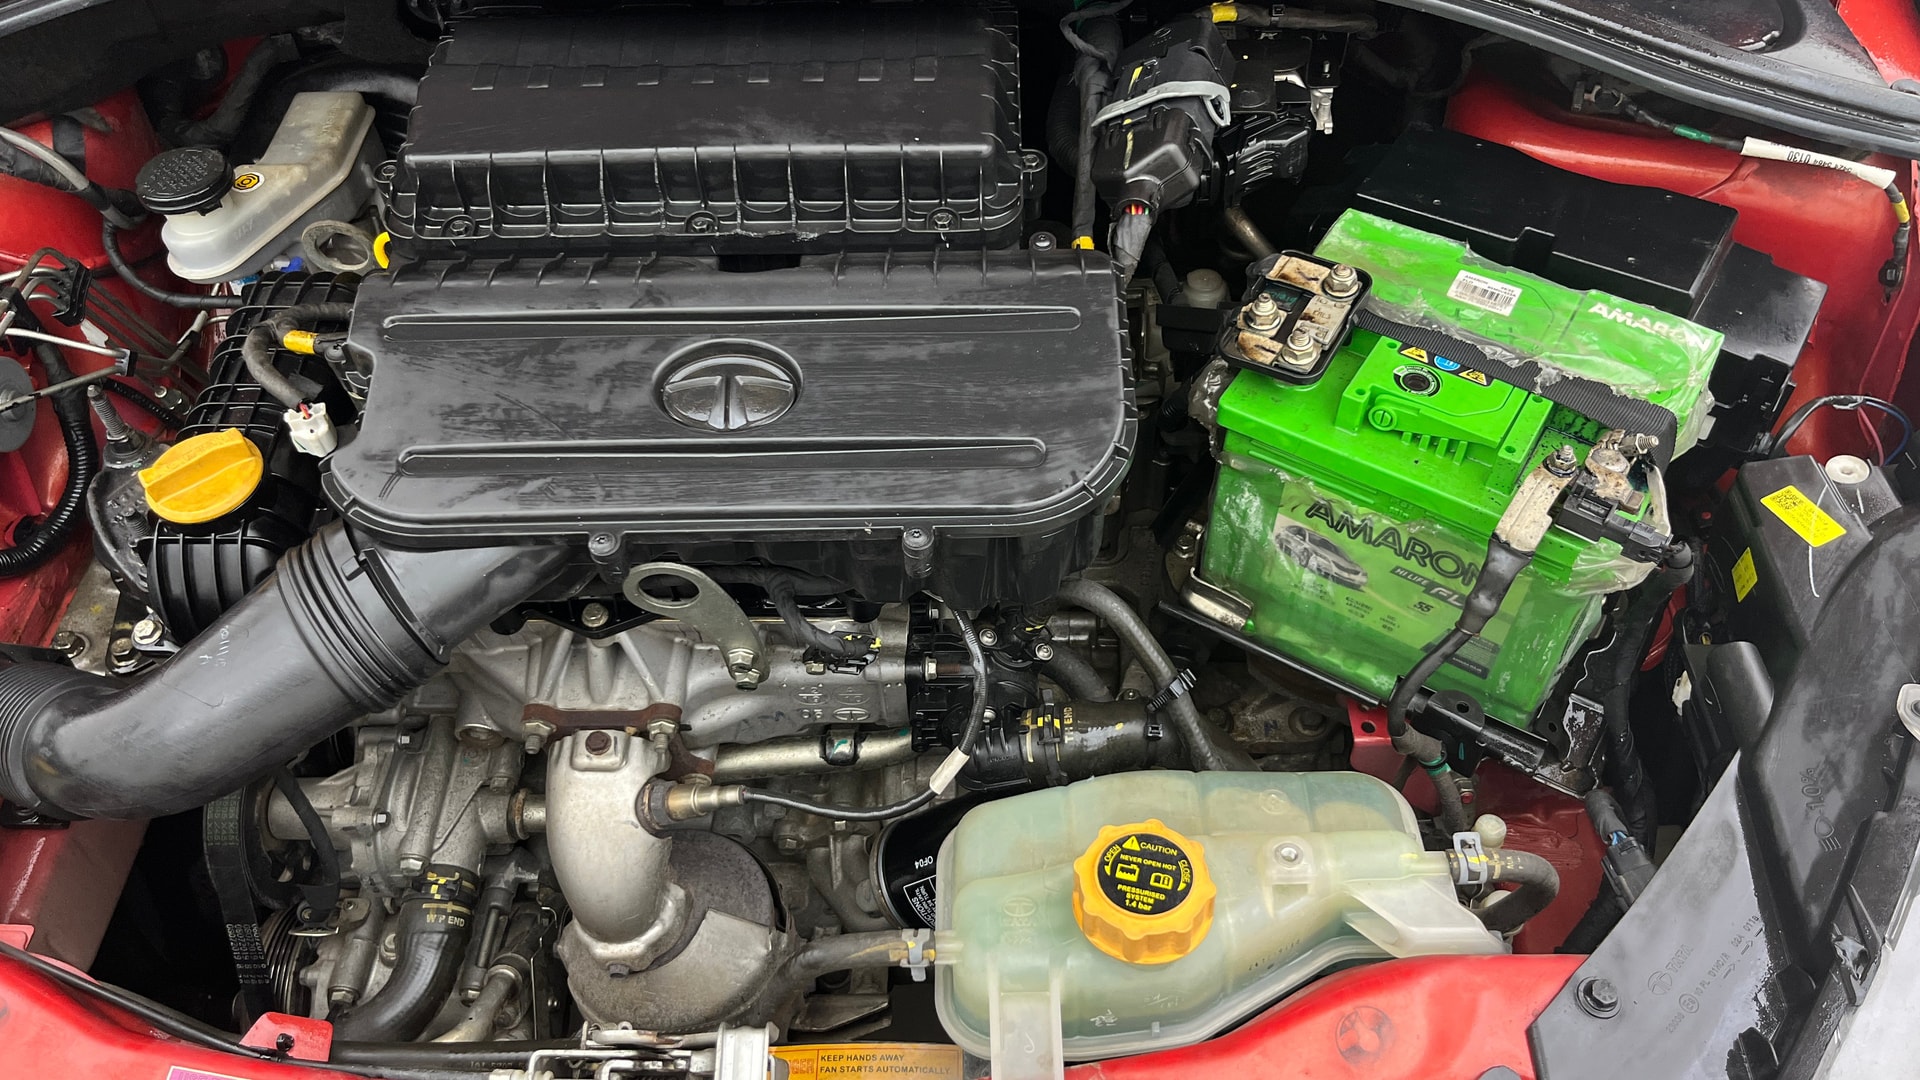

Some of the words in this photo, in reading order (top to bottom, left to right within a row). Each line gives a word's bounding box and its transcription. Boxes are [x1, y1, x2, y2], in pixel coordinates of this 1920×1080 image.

[1787, 151, 1810, 164] 0130
[1394, 567, 1408, 576] HI
[1407, 572, 1429, 586] LIFE
[1063, 706, 1073, 724] END
[1064, 726, 1074, 744] TH
[1104, 844, 1122, 862] OPEN
[1140, 841, 1178, 857] CAUTION
[1120, 853, 1142, 864] NEVER
[1143, 858, 1162, 868] OPEN
[1162, 862, 1177, 871] HOT
[1180, 859, 1191, 883] CLOSE
[1117, 884, 1166, 901] PRESSURISED
[1126, 893, 1155, 904] SYSTEM
[1125, 899, 1137, 908] 1.4
[1138, 901, 1152, 911] bar
[448, 916, 465, 927] END
[1665, 944, 1694, 973] TATA
[820, 1054, 844, 1062] KEEP
[846, 1054, 878, 1062] HANDS
[880, 1054, 904, 1062] AWAY
[820, 1065, 838, 1073] FAN
[840, 1065, 874, 1073] STARTS
[877, 1065, 950, 1074] AUTOMATICALLY
